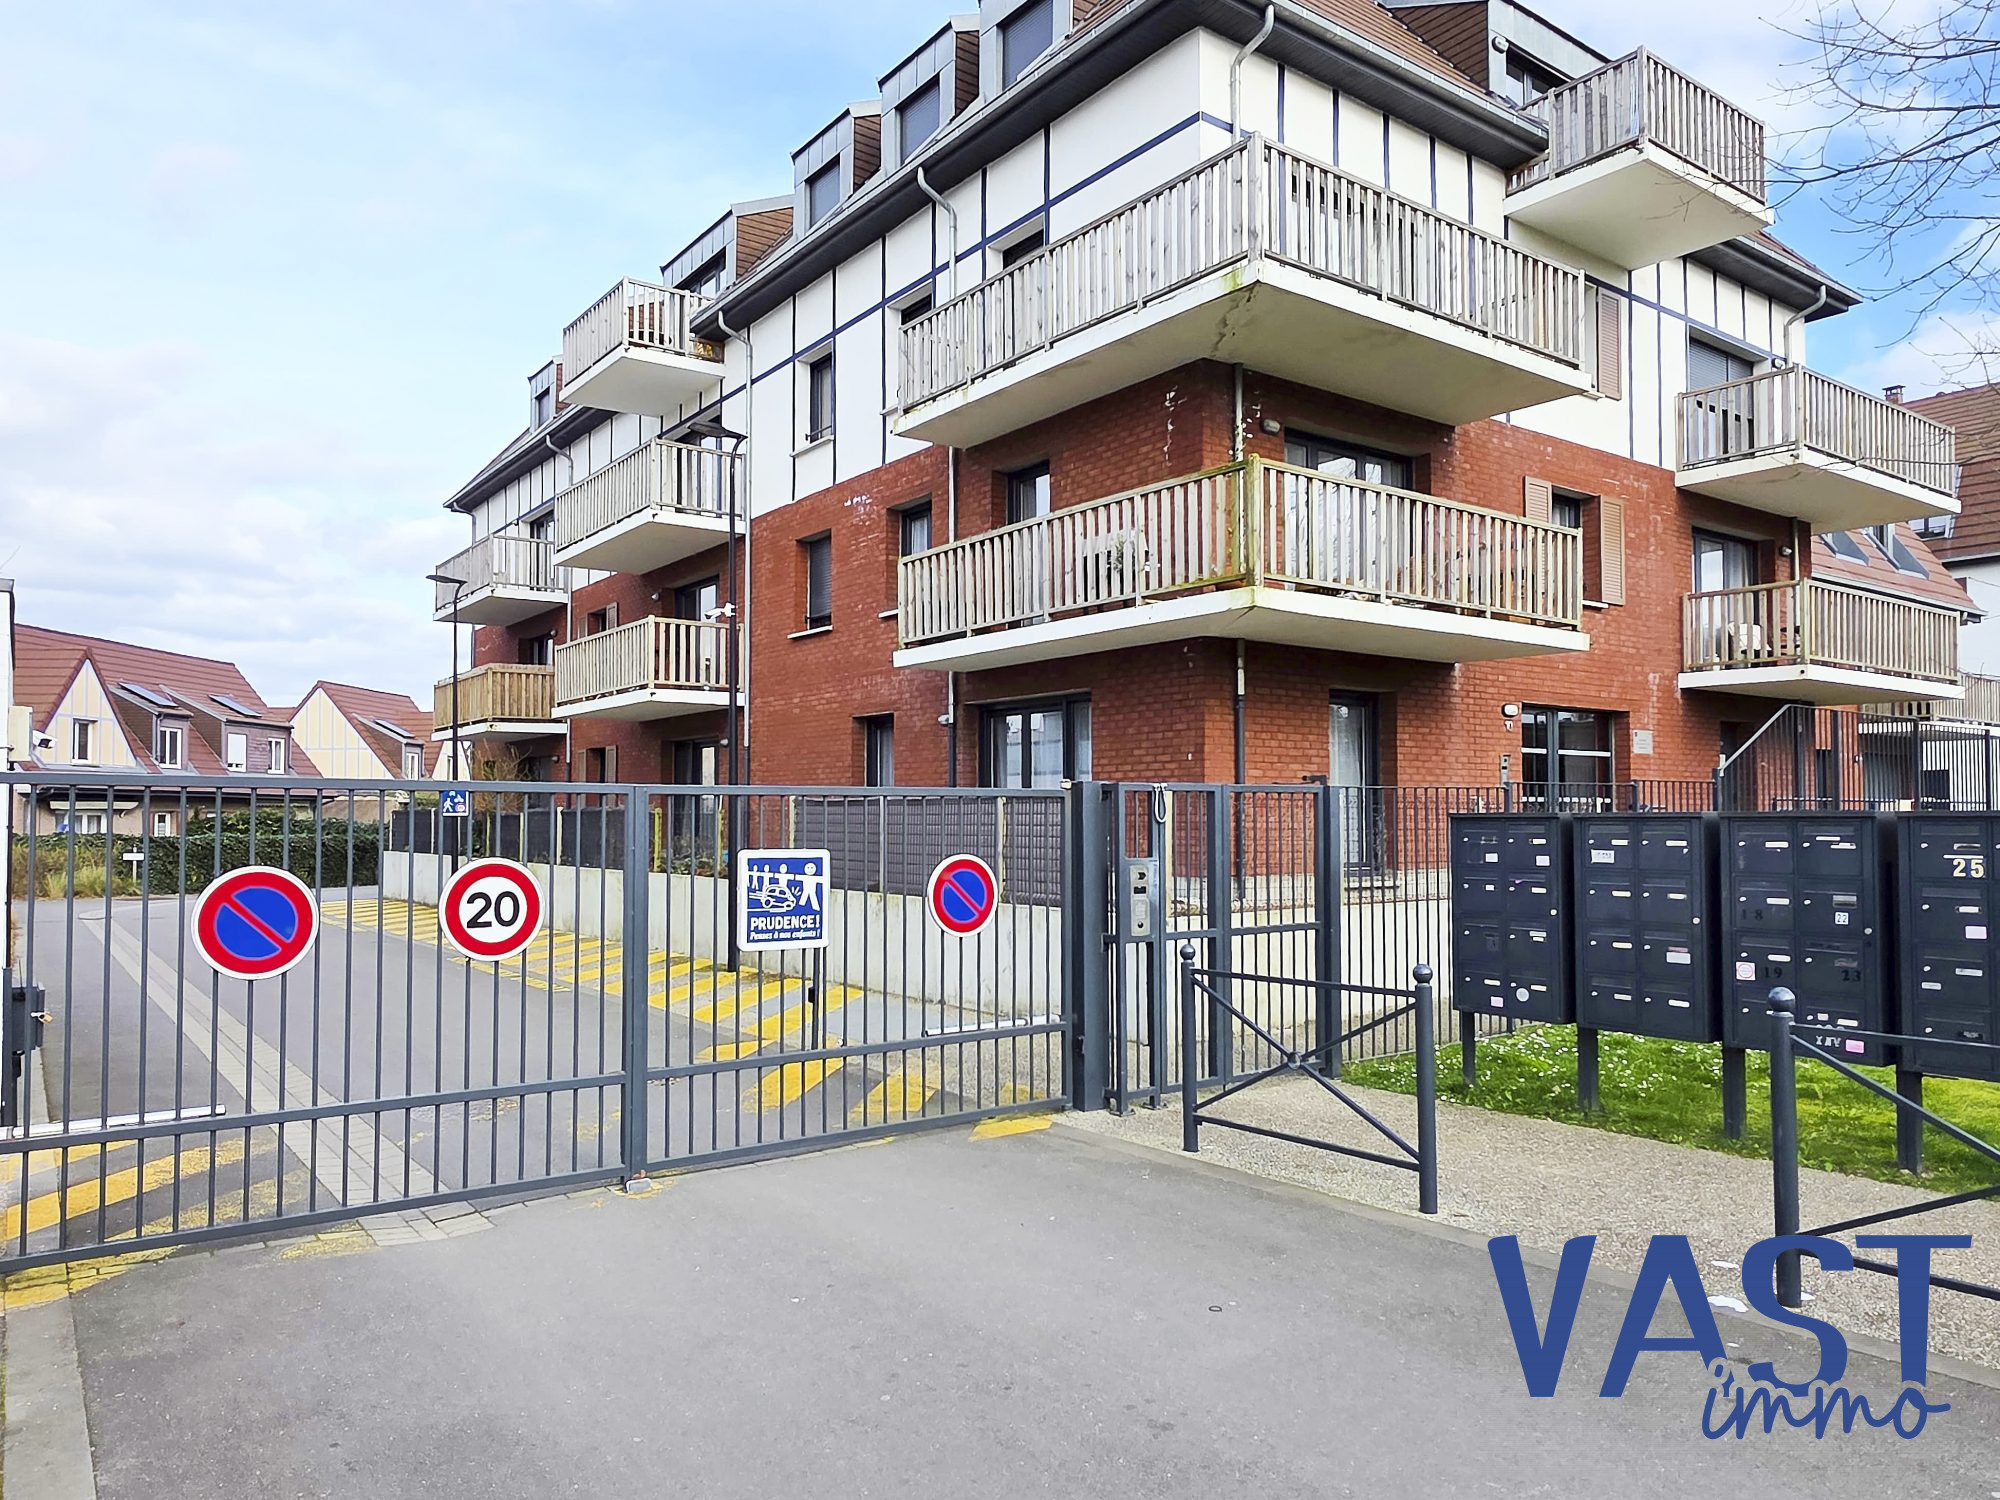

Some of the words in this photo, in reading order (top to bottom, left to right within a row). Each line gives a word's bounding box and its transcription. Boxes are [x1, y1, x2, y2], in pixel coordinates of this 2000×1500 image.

[1952, 858, 1985, 878] 25
[466, 890, 520, 929] 20
[1836, 913, 1848, 923] 22
[1764, 966, 1782, 978] 19
[1841, 969, 1861, 981] 23
